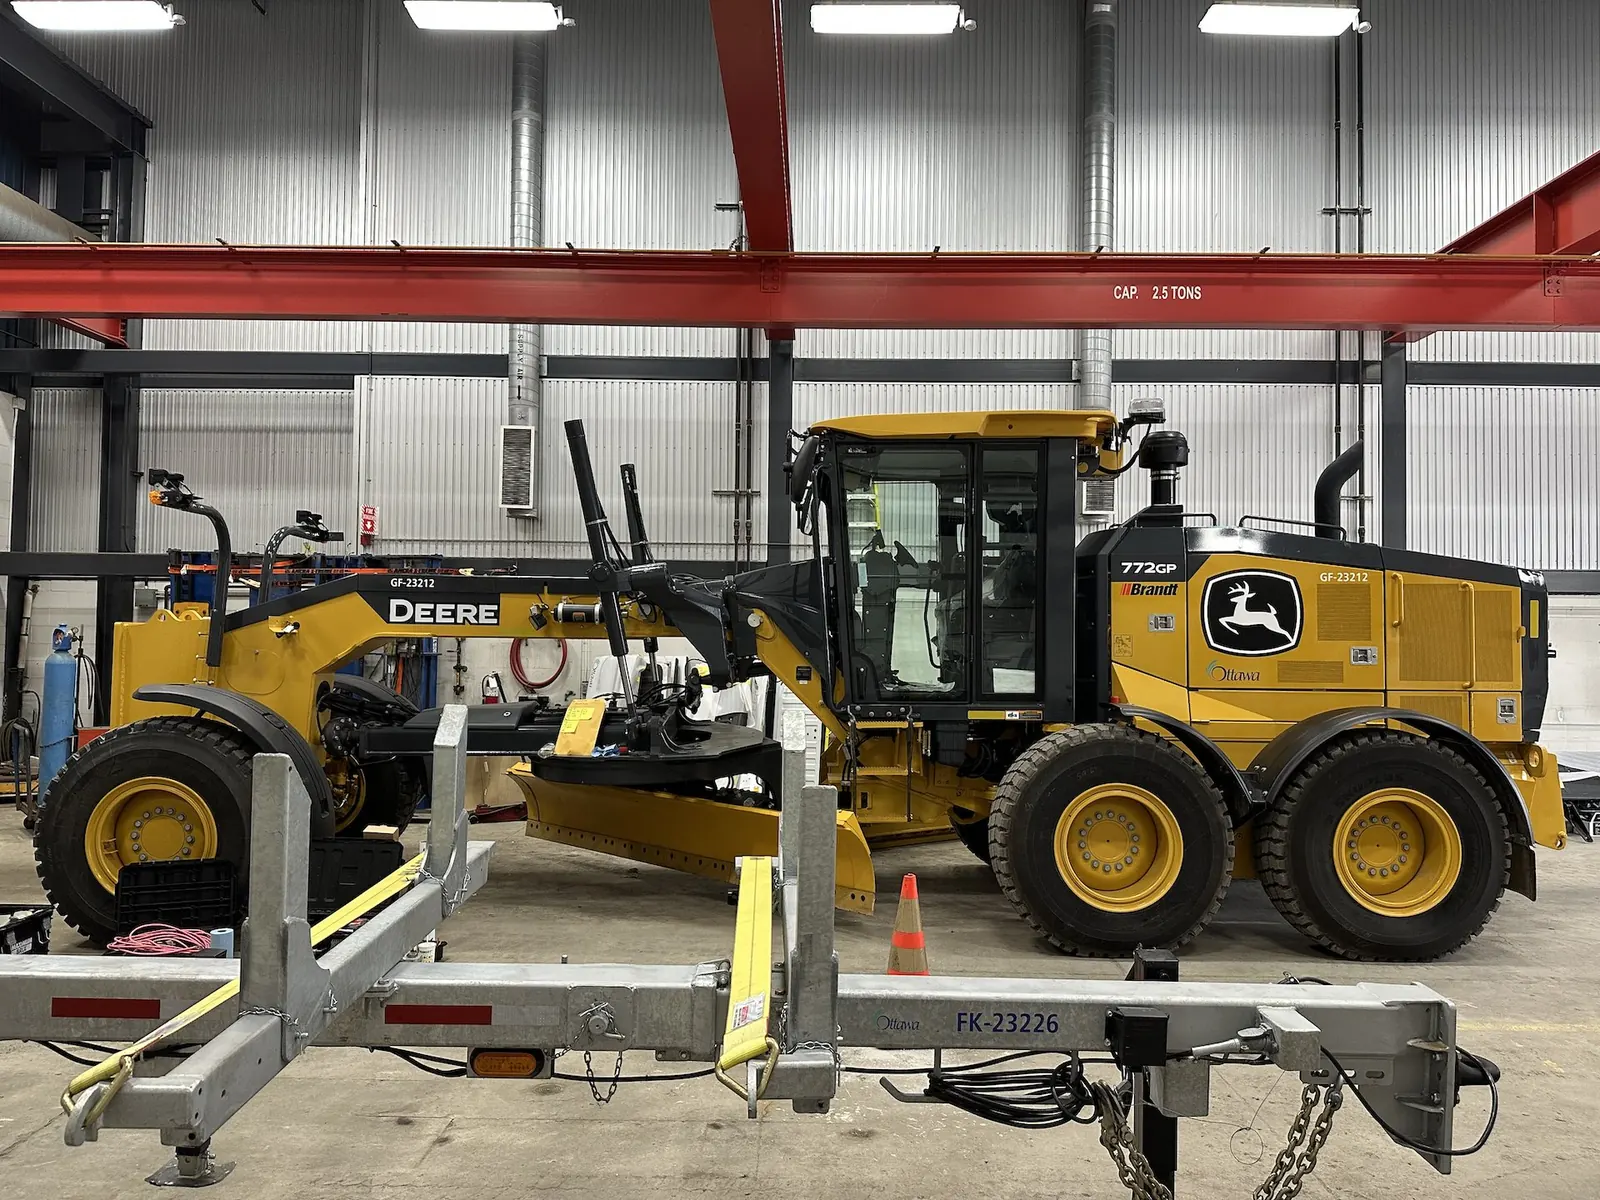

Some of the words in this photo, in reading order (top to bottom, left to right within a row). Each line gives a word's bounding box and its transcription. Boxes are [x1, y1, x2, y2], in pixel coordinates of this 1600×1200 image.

[1113, 285, 1139, 299] CAP.
[1152, 285, 1168, 299] 2.5
[1170, 285, 1202, 299] TONS
[1121, 562, 1177, 574] 772GP
[390, 578, 435, 588] GF-23212
[1319, 572, 1369, 582] GF-23212
[1130, 583, 1179, 596] Brandt
[389, 599, 499, 624] DEERE
[1210, 665, 1260, 681] Ottawa
[876, 1014, 920, 1031] Ottawa
[956, 1012, 1060, 1033] FK-23226
